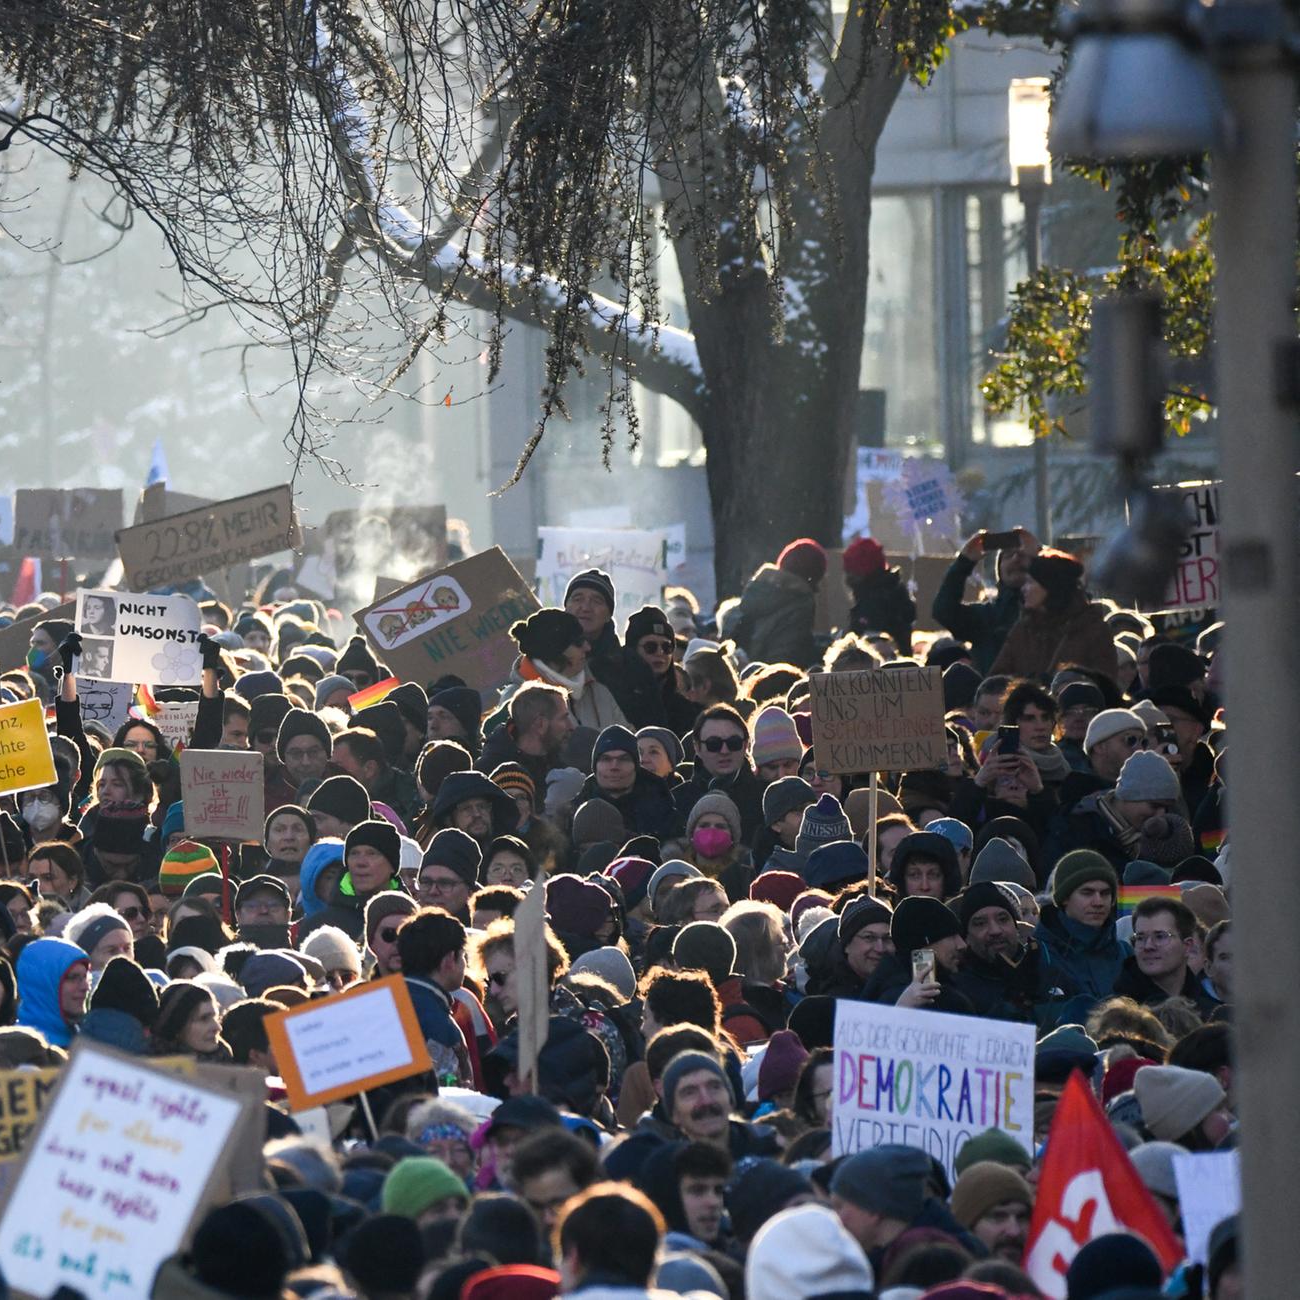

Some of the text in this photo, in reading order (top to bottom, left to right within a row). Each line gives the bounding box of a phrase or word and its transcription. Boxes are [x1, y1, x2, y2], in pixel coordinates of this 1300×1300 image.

[222, 502, 277, 541] MEHR
[119, 603, 167, 617] NICHT
[422, 621, 469, 663] NIE
[815, 693, 904, 722] UNS UM
[193, 764, 258, 781] Nie wieder
[212, 784, 228, 797] ist
[200, 799, 232, 821] jetzt
[837, 1020, 862, 1048] AUS
[867, 1022, 891, 1050] DER
[840, 1050, 1023, 1131] DEMOKRATIE
